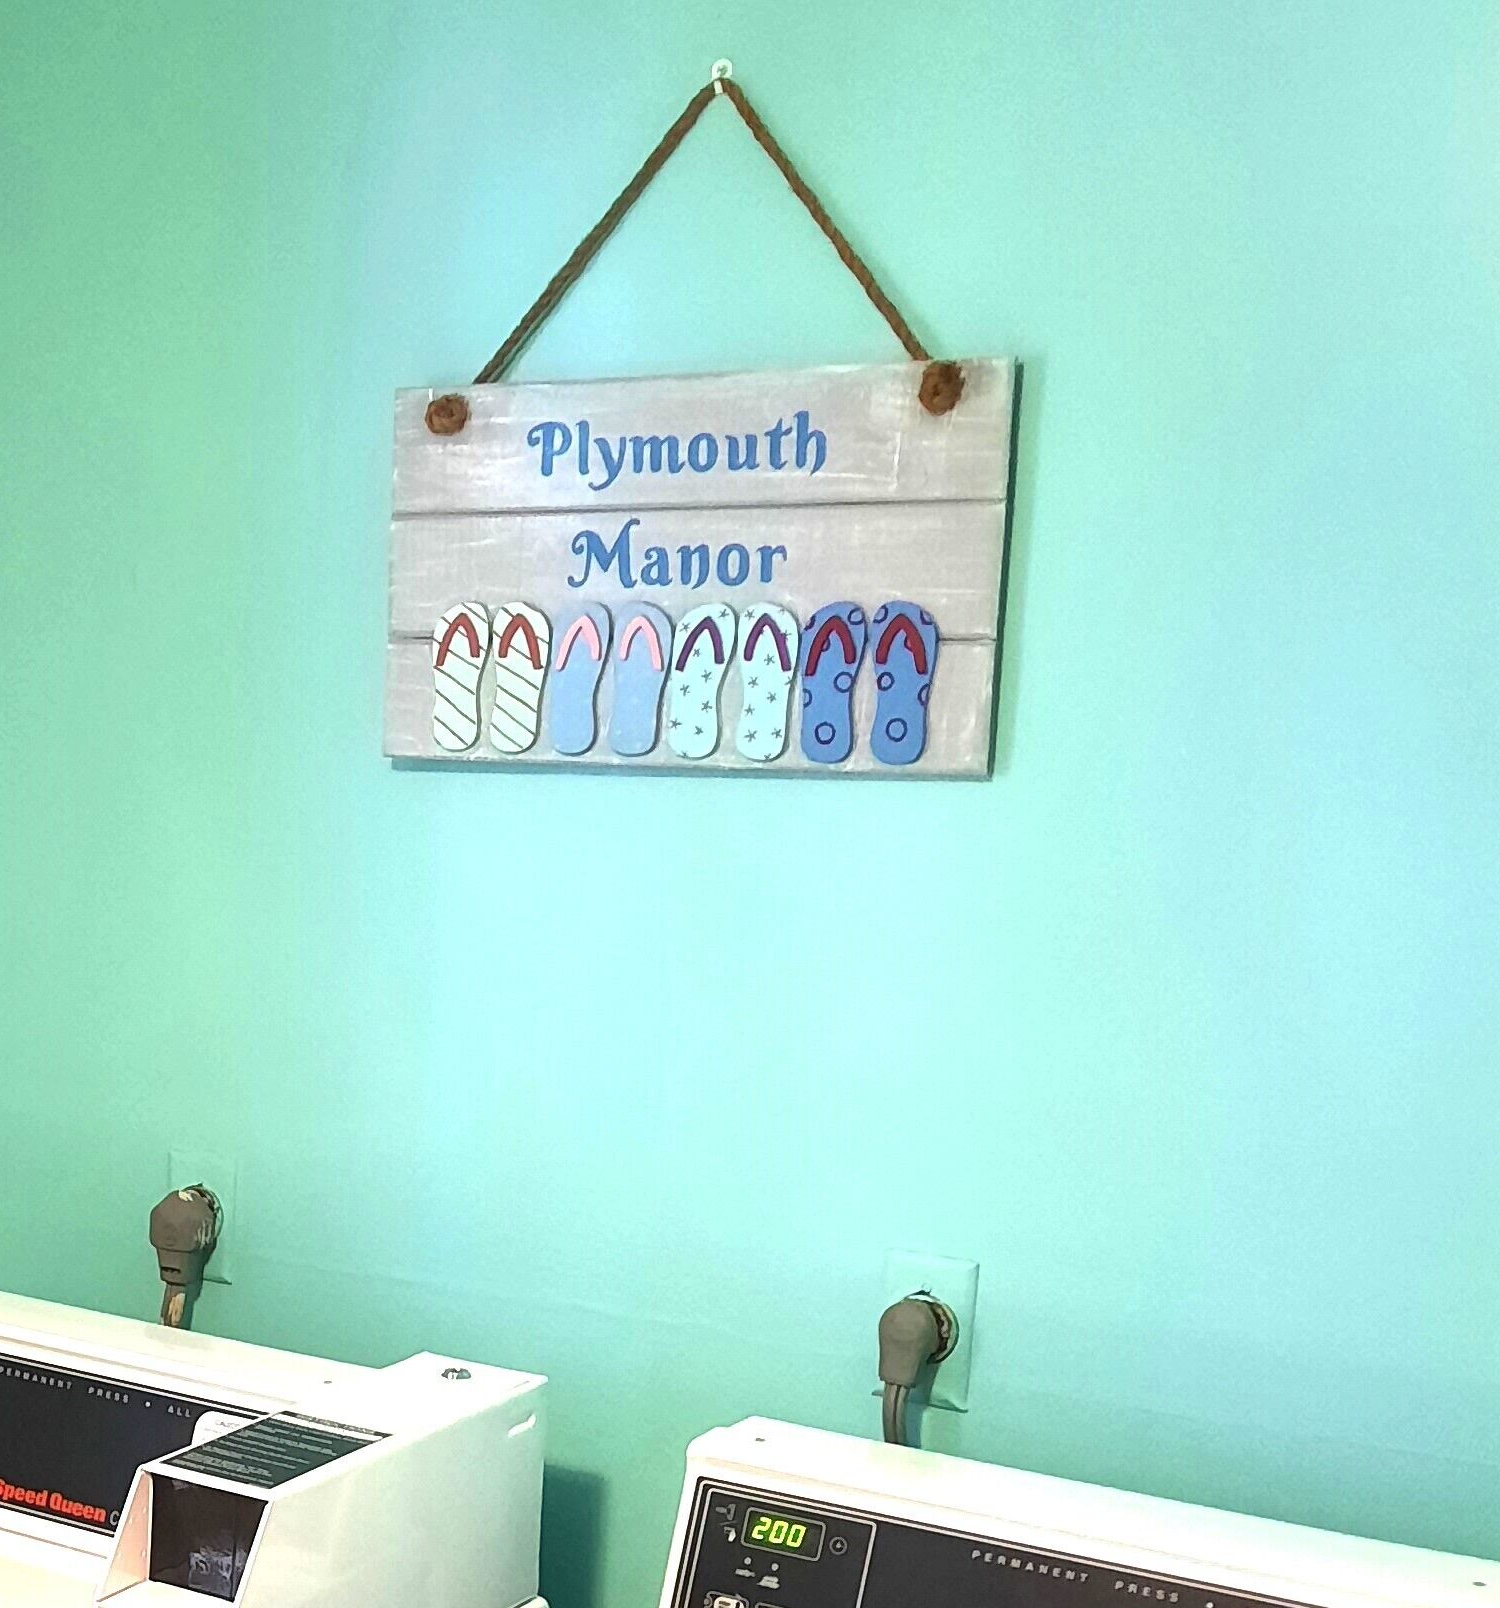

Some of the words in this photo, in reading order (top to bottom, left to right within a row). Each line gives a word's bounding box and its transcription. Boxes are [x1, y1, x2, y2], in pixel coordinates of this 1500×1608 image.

[527, 410, 829, 492] Plymouth
[567, 518, 787, 590] Manor
[88, 1385, 130, 1404] PRESS
[167, 1404, 192, 1418] ALL
[49, 1490, 107, 1524] Queen
[752, 1516, 807, 1548] 200
[971, 1548, 1091, 1583] PERMANENT
[1114, 1579, 1181, 1604] PRESS
